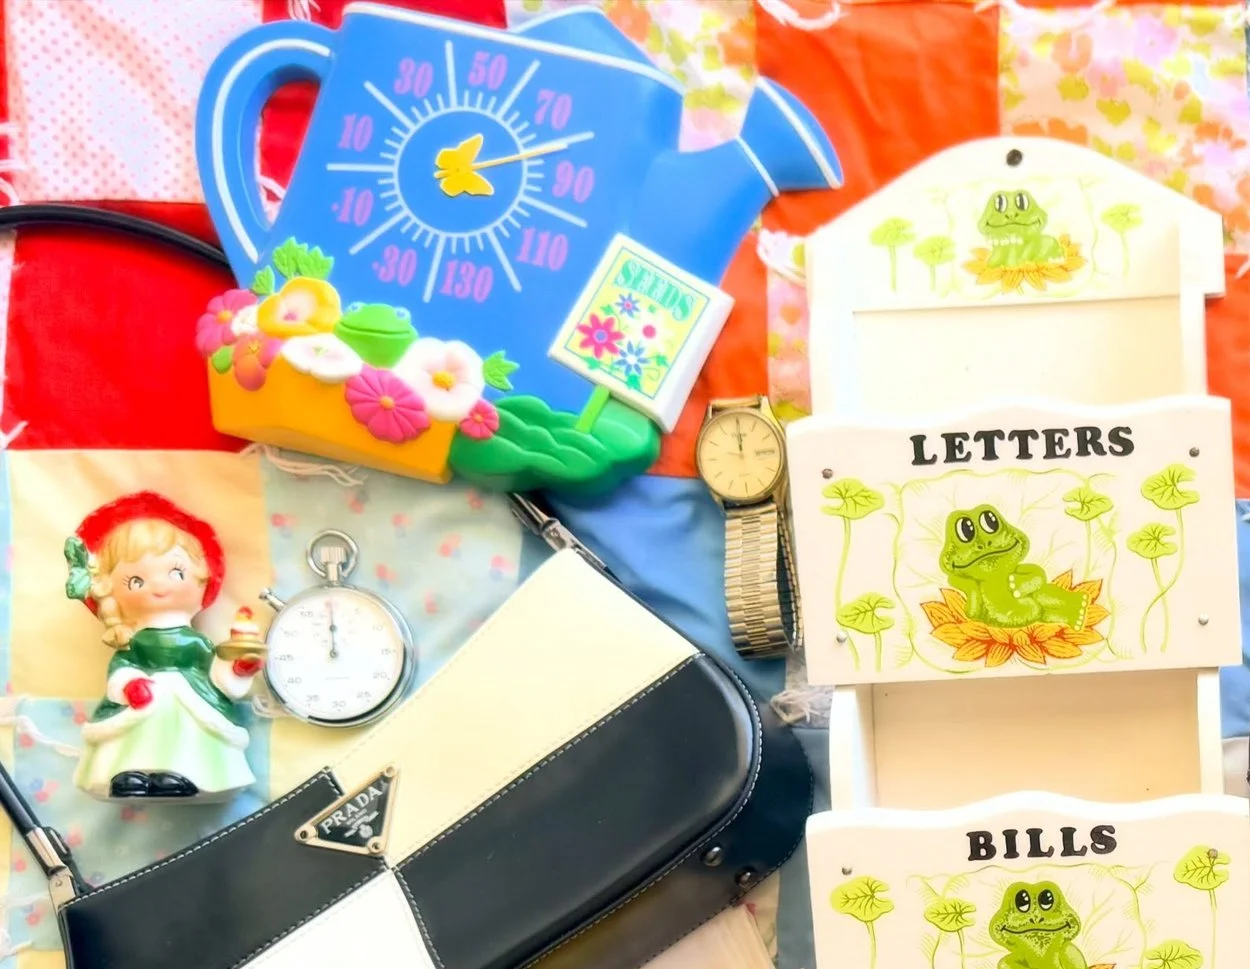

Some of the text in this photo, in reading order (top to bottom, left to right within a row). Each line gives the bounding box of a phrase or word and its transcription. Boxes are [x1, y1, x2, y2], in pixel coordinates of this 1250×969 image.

[394, 57, 433, 99] 30
[469, 51, 508, 91] 50
[535, 89, 573, 131] 70
[338, 114, 374, 153] 10
[552, 160, 595, 203] 90
[516, 227, 568, 271] 110
[441, 260, 494, 303] 130
[614, 258, 695, 321] SEEDS
[909, 425, 1135, 466] LETTERS
[320, 786, 383, 834] PRADA
[966, 824, 1117, 861] BILLS
